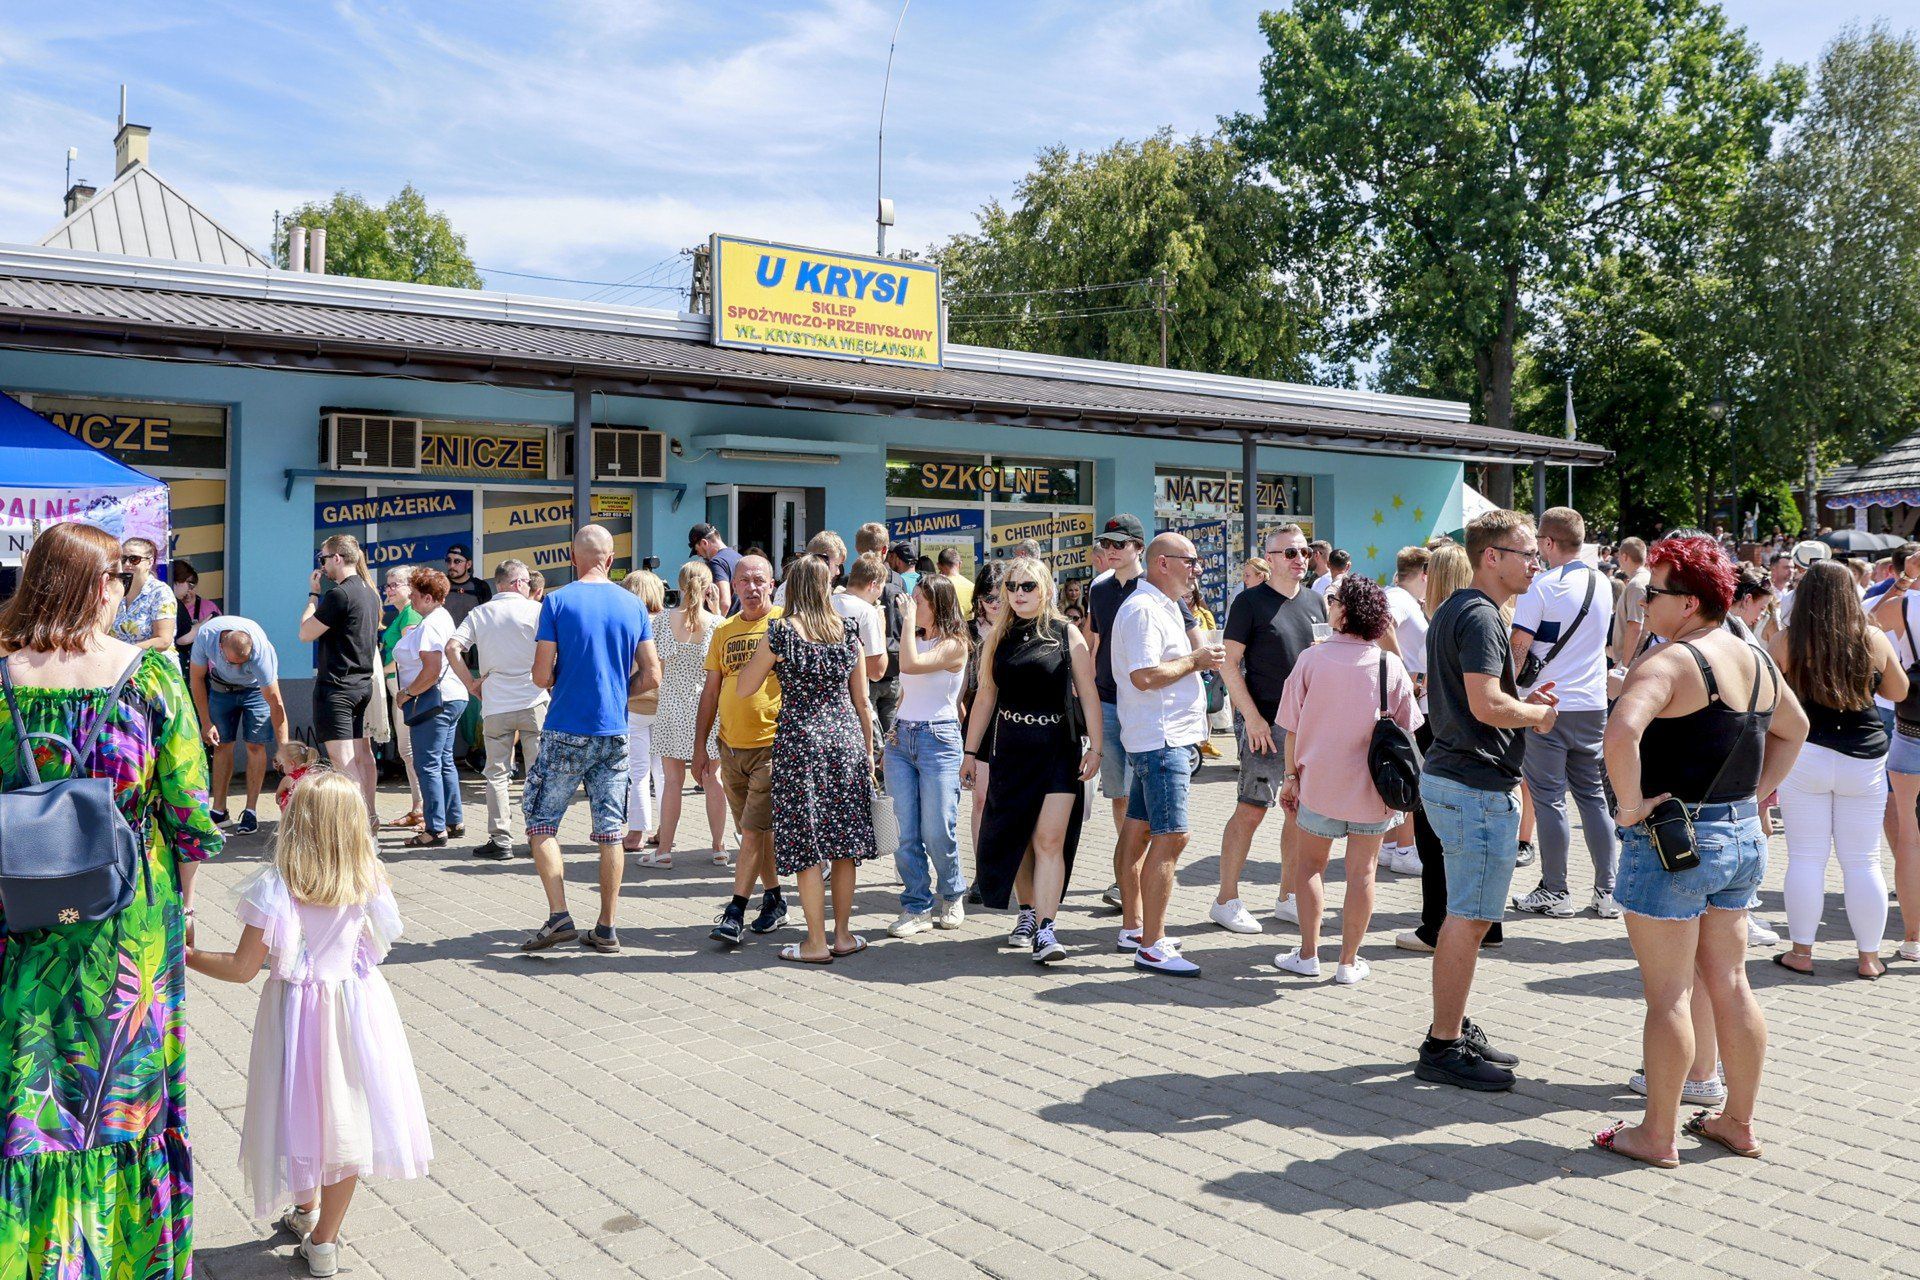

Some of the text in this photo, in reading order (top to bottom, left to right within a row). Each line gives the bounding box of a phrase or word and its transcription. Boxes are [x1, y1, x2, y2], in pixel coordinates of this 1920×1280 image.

[756, 254, 909, 307] U KRYSI
[811, 301, 857, 317] SKLEP
[727, 305, 934, 342] SPOŻYWCZO-PRZEMYSŁOWY
[764, 327, 840, 350] KRYSTYNA
[921, 462, 1050, 495] SZKOLNE
[322, 494, 457, 524] GARMAŻERKA
[894, 513, 961, 535] ZABAWKI
[1004, 518, 1079, 542] CHEMICZNE
